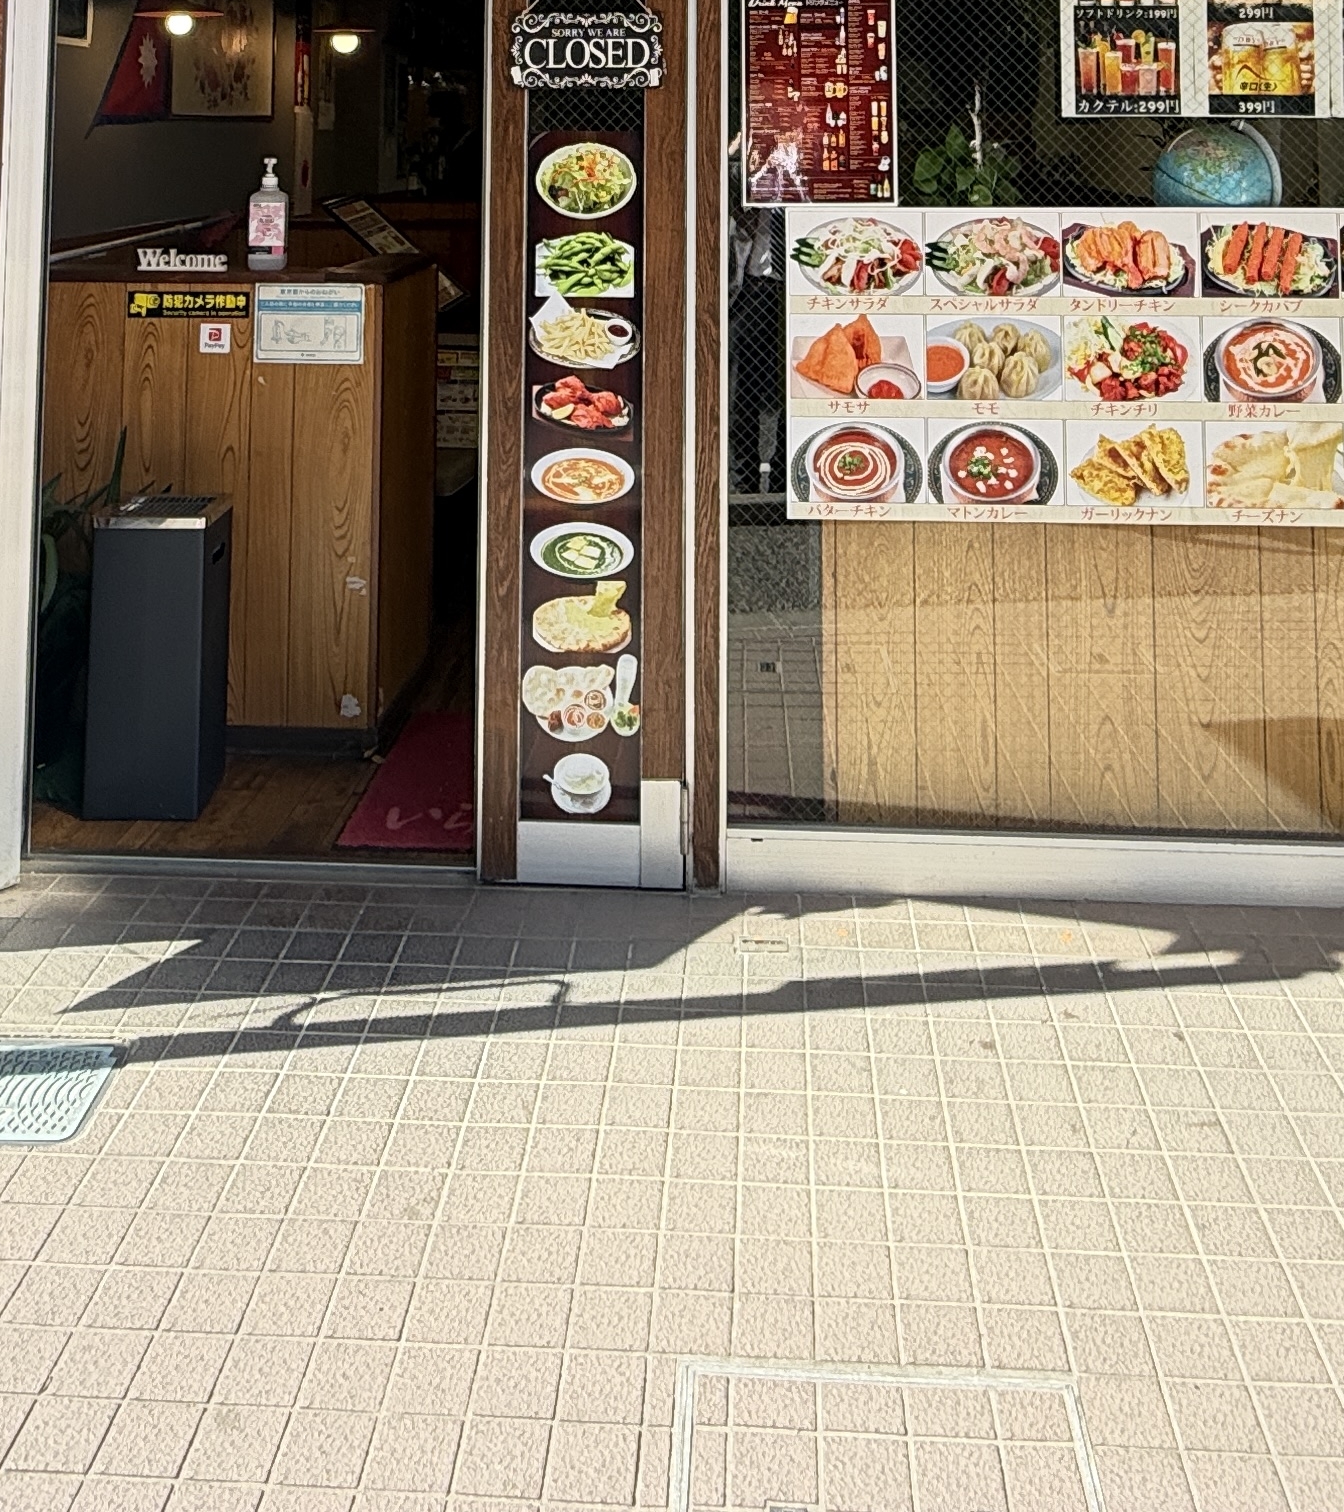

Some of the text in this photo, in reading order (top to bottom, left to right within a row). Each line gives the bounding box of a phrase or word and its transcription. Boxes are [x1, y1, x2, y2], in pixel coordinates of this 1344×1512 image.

[551, 28, 626, 37] SORRY WE ARE
[524, 39, 650, 69] CLOSED
[1238, 101, 1276, 114] 399円
[137, 248, 228, 269] Welcome
[162, 294, 246, 309] 防犯カメラ作動中
[806, 297, 889, 310] チキンサラダ
[930, 298, 1038, 312] スペシャルサラダ
[1070, 299, 1175, 313] タンドリーチキン
[1219, 299, 1303, 313] シークカバブ
[827, 401, 870, 414] サモサ
[971, 403, 1000, 415] モモ
[1090, 403, 1159, 418] チキンチリ
[1227, 404, 1301, 419] 野菜カレー
[807, 504, 892, 517] バターチキン
[946, 506, 1028, 519] マトンカレー
[1080, 507, 1173, 522] ガーリックナン
[1231, 509, 1303, 524] チーズナン
